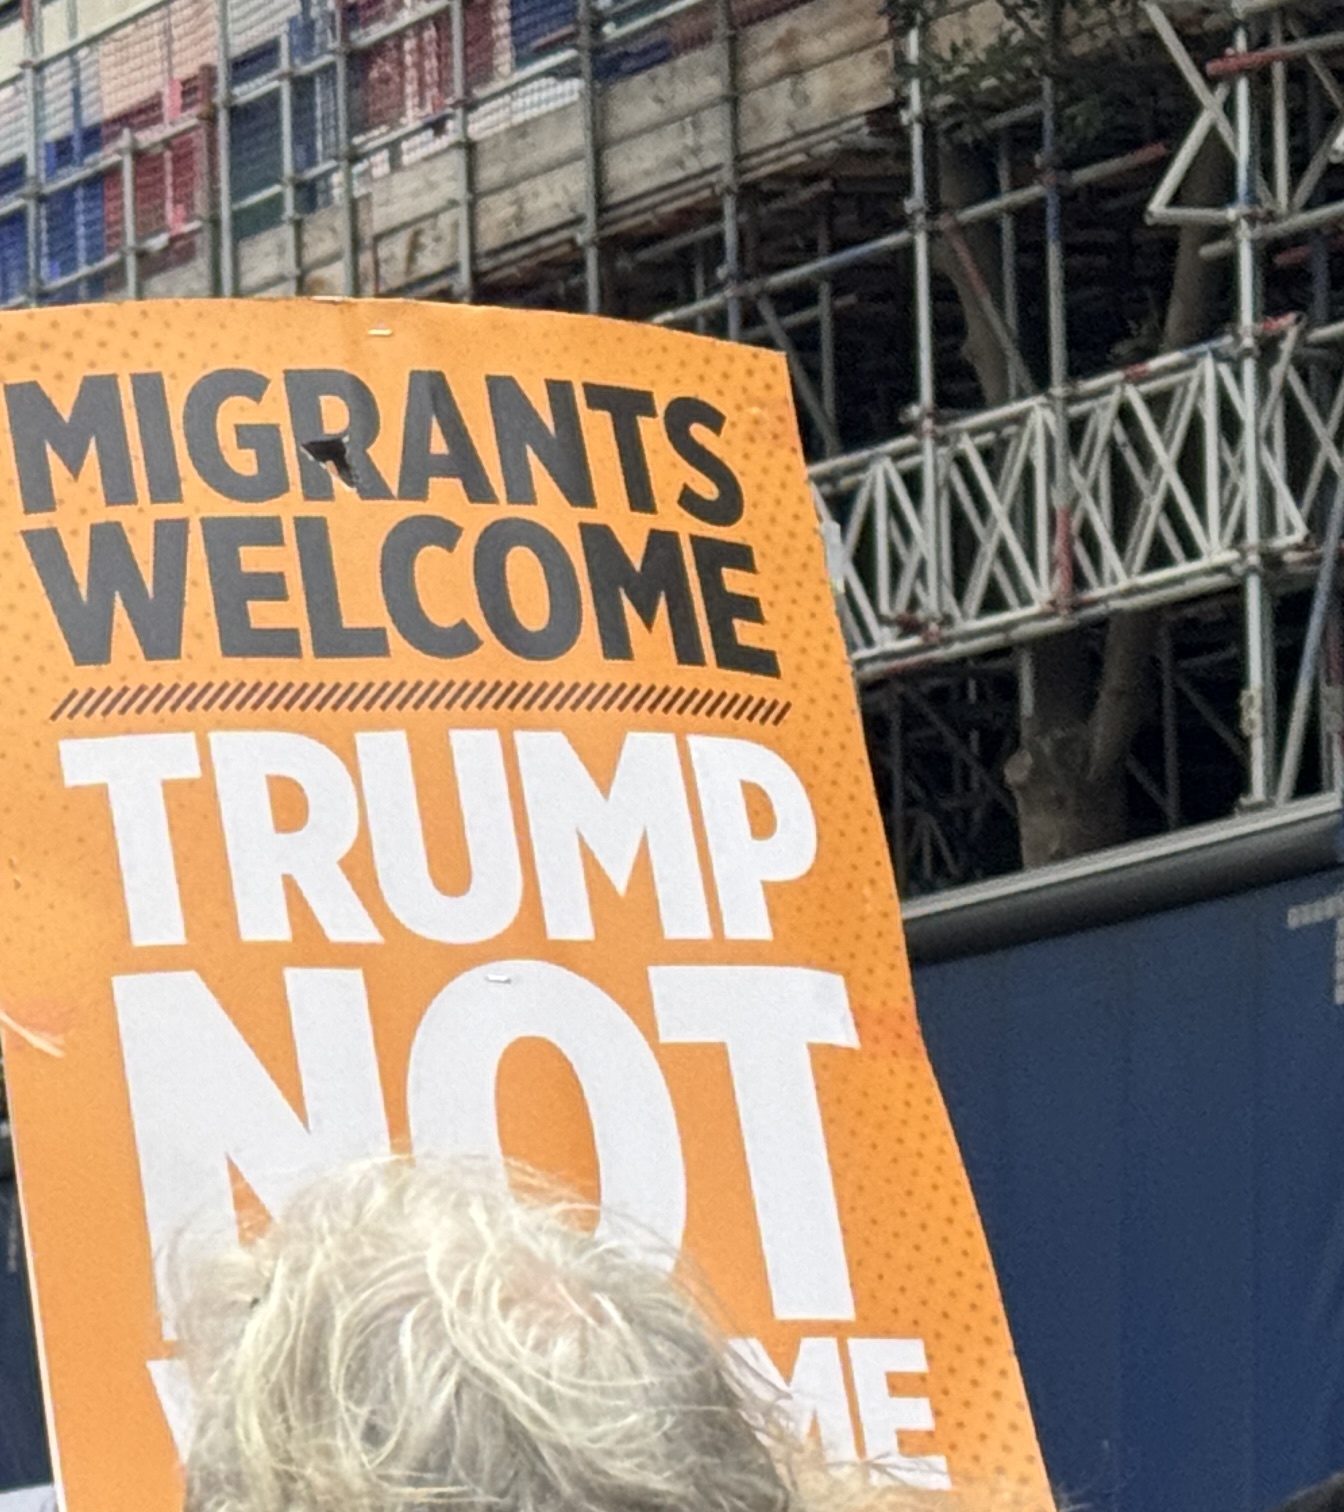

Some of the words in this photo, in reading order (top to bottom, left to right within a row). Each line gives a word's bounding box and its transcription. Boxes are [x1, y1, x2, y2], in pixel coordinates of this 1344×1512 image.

[3, 368, 745, 527] MIGRANTS
[19, 514, 782, 678] WELCOME
[58, 729, 817, 947] TRUMP
[112, 958, 860, 1342] NOT
